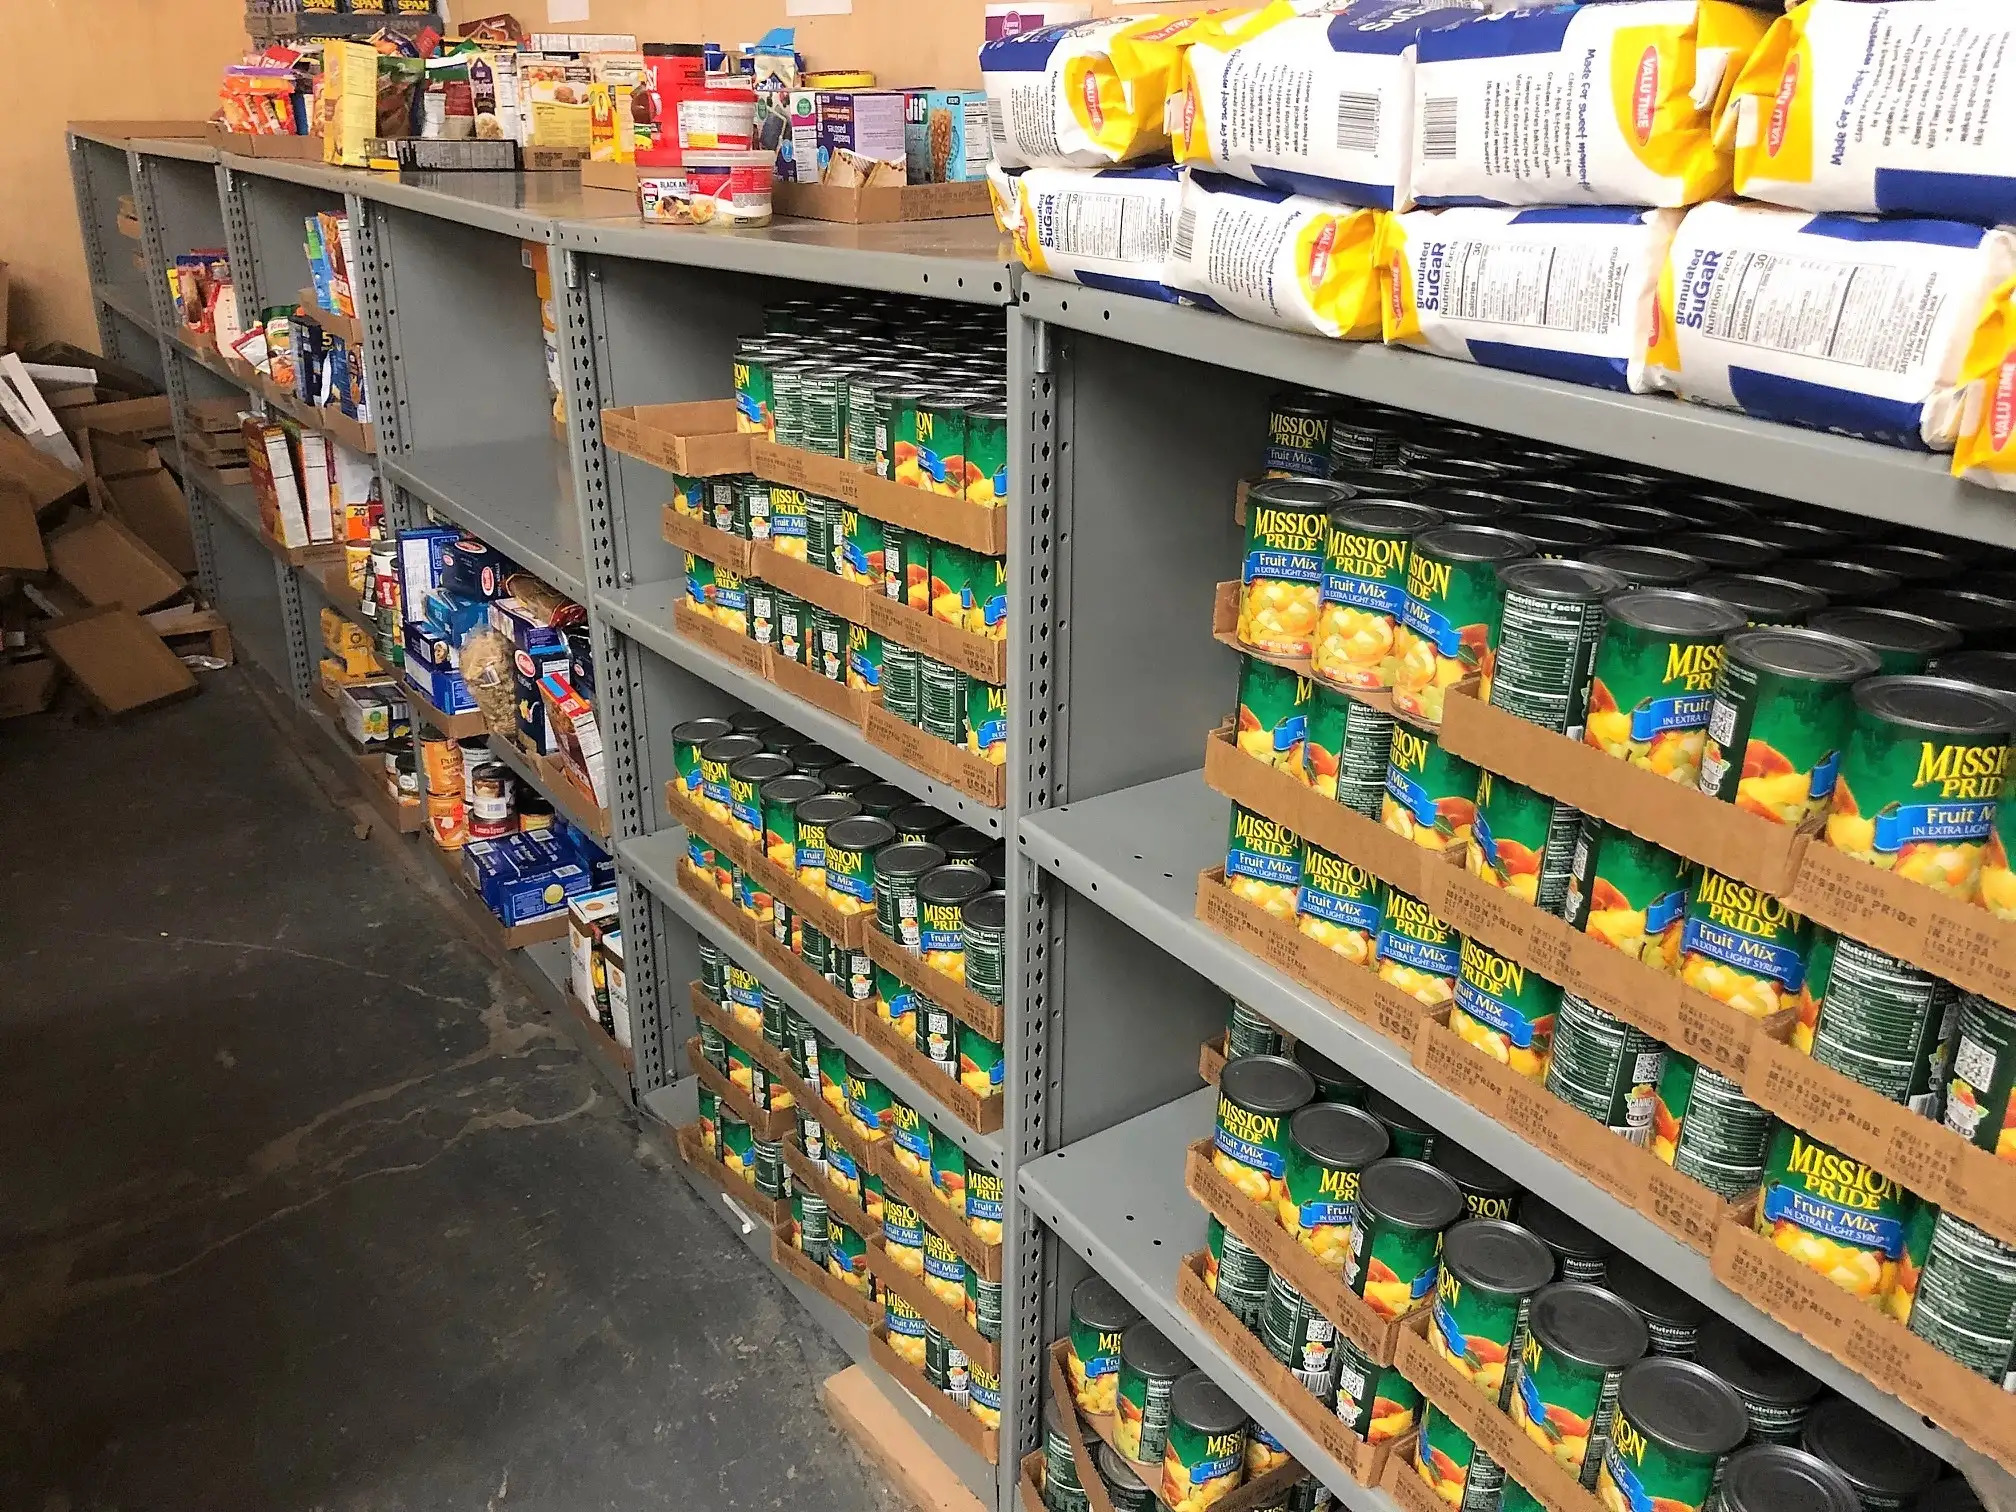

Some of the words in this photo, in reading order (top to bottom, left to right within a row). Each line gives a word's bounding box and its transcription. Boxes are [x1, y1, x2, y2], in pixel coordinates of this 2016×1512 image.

[351, 0, 383, 8] SPAM
[398, 0, 430, 10] SPAM
[1582, 49, 1596, 79] Made
[1641, 58, 1655, 95] VALU
[1580, 83, 1590, 99] for
[1845, 70, 1870, 105] sweet
[1221, 91, 1229, 120] sweet
[1637, 96, 1650, 128] TIME
[1576, 103, 1587, 139] sweet
[1836, 110, 1850, 129] for
[1222, 139, 1230, 161] Made
[1830, 132, 1846, 165] Made
[1754, 254, 1768, 270] 30
[1416, 242, 1431, 308] granulated
[1442, 268, 1451, 315] Nutrition
[1676, 250, 1704, 325] granulated
[1705, 286, 1723, 335] Nutrition
[1720, 250, 1738, 286] Facts
[1269, 411, 1328, 445] MISSION
[1275, 434, 1313, 449] PRIDE
[1293, 453, 1314, 464] Mix
[776, 504, 806, 515] PRIDE
[1254, 507, 1327, 540] MISSION
[1265, 534, 1317, 551] PRIDE
[1327, 527, 1408, 574] MISSION
[1259, 553, 1286, 567] Fruit
[1291, 557, 1317, 570] Mix
[1335, 557, 1387, 579] PRIDE
[1262, 567, 1281, 577] EXTRA
[1281, 569, 1300, 579] LIGHT
[726, 592, 741, 600] Mix
[1330, 577, 1355, 593] Fruit
[1359, 582, 1387, 599] Mix
[1331, 591, 1350, 602] EXTRA
[1350, 595, 1369, 606] LIGHT
[1371, 599, 1394, 609] SYRUP
[1507, 592, 1548, 608] Nutrition
[1551, 602, 1581, 612] Facts
[1410, 603, 1431, 623] Mix
[1675, 715, 1700, 724] EXTRA
[708, 784, 721, 794] Mix
[1392, 771, 1409, 792] Mix
[734, 803, 746, 814] Mix
[1927, 809, 1975, 824] Fruit
[1912, 826, 1926, 836] IN
[1929, 825, 1962, 835] EXTRA
[1964, 824, 1991, 834] LIGHT
[803, 850, 820, 859] Fruit
[1245, 836, 1292, 857] PRIDE
[1239, 853, 1264, 868] Fruit
[1271, 860, 1292, 874] Mix
[1260, 868, 1278, 879] LIGHT
[1304, 846, 1377, 895] MISSION
[837, 875, 853, 886] Mix
[1312, 874, 1362, 899] PRIDE
[1307, 891, 1333, 909] Fruit
[1336, 899, 1361, 916] Mix
[1697, 866, 1800, 934] MISSION
[1326, 907, 1344, 919] LIGHT
[1345, 912, 1366, 924] SYRUP
[1446, 889, 1488, 918] MISSION
[1492, 914, 1524, 936] PRIDE
[1709, 904, 1778, 938] PRIDE
[1872, 900, 1917, 928] PRIDE
[931, 934, 950, 942] Fruit
[1242, 920, 1264, 937] PRIDE
[1395, 918, 1447, 945] PRIDE
[1389, 936, 1416, 954] Fruit
[1421, 945, 1448, 962] Mix
[1700, 924, 1733, 950] Fruit
[1739, 941, 1776, 962] Mix
[1840, 939, 1893, 965] Nutrition
[1408, 953, 1427, 965] LIGHT
[1700, 942, 1723, 956] EXTRA
[1725, 949, 1751, 964] LIGHT
[1753, 959, 1782, 973] SYRUP
[1460, 963, 1503, 997] PRIDE
[740, 991, 753, 1000] Mix
[1476, 993, 1502, 1017] Mix
[1485, 1012, 1509, 1028] SYRUP
[1218, 1091, 1280, 1142] MISSION
[1838, 1107, 1881, 1137] PRIDE
[899, 1130, 913, 1143] Mix
[1223, 1118, 1263, 1145] PRIDE
[1219, 1131, 1237, 1147] Fruit
[1240, 1142, 1264, 1160] Mix
[1787, 1134, 1902, 1204] MISSION
[1805, 1174, 1881, 1210] PRIDE
[973, 1200, 992, 1211] Fruit
[1793, 1194, 1835, 1220] Fruit
[1840, 1214, 1879, 1232] Mix
[887, 1212, 917, 1229] PRIDE
[1794, 1211, 1823, 1229] EXTRA
[1825, 1221, 1855, 1237] LIGHT
[1856, 1231, 1884, 1243] SYRUP
[885, 1225, 900, 1237] Fruit
[902, 1230, 919, 1240] Mix
[927, 1245, 957, 1262] PRIDE
[1566, 1258, 1604, 1268] Nutrition
[924, 1257, 940, 1269] Fruit
[940, 1264, 959, 1274] Mix
[890, 1316, 905, 1327] Fruit
[1802, 1297, 1842, 1328] PRIDE
[1649, 1322, 1690, 1336] Nutrition
[970, 1372, 999, 1390] PRIDE
[1745, 1402, 1788, 1416] Nutrition
[1213, 1459, 1235, 1470] Fruit
